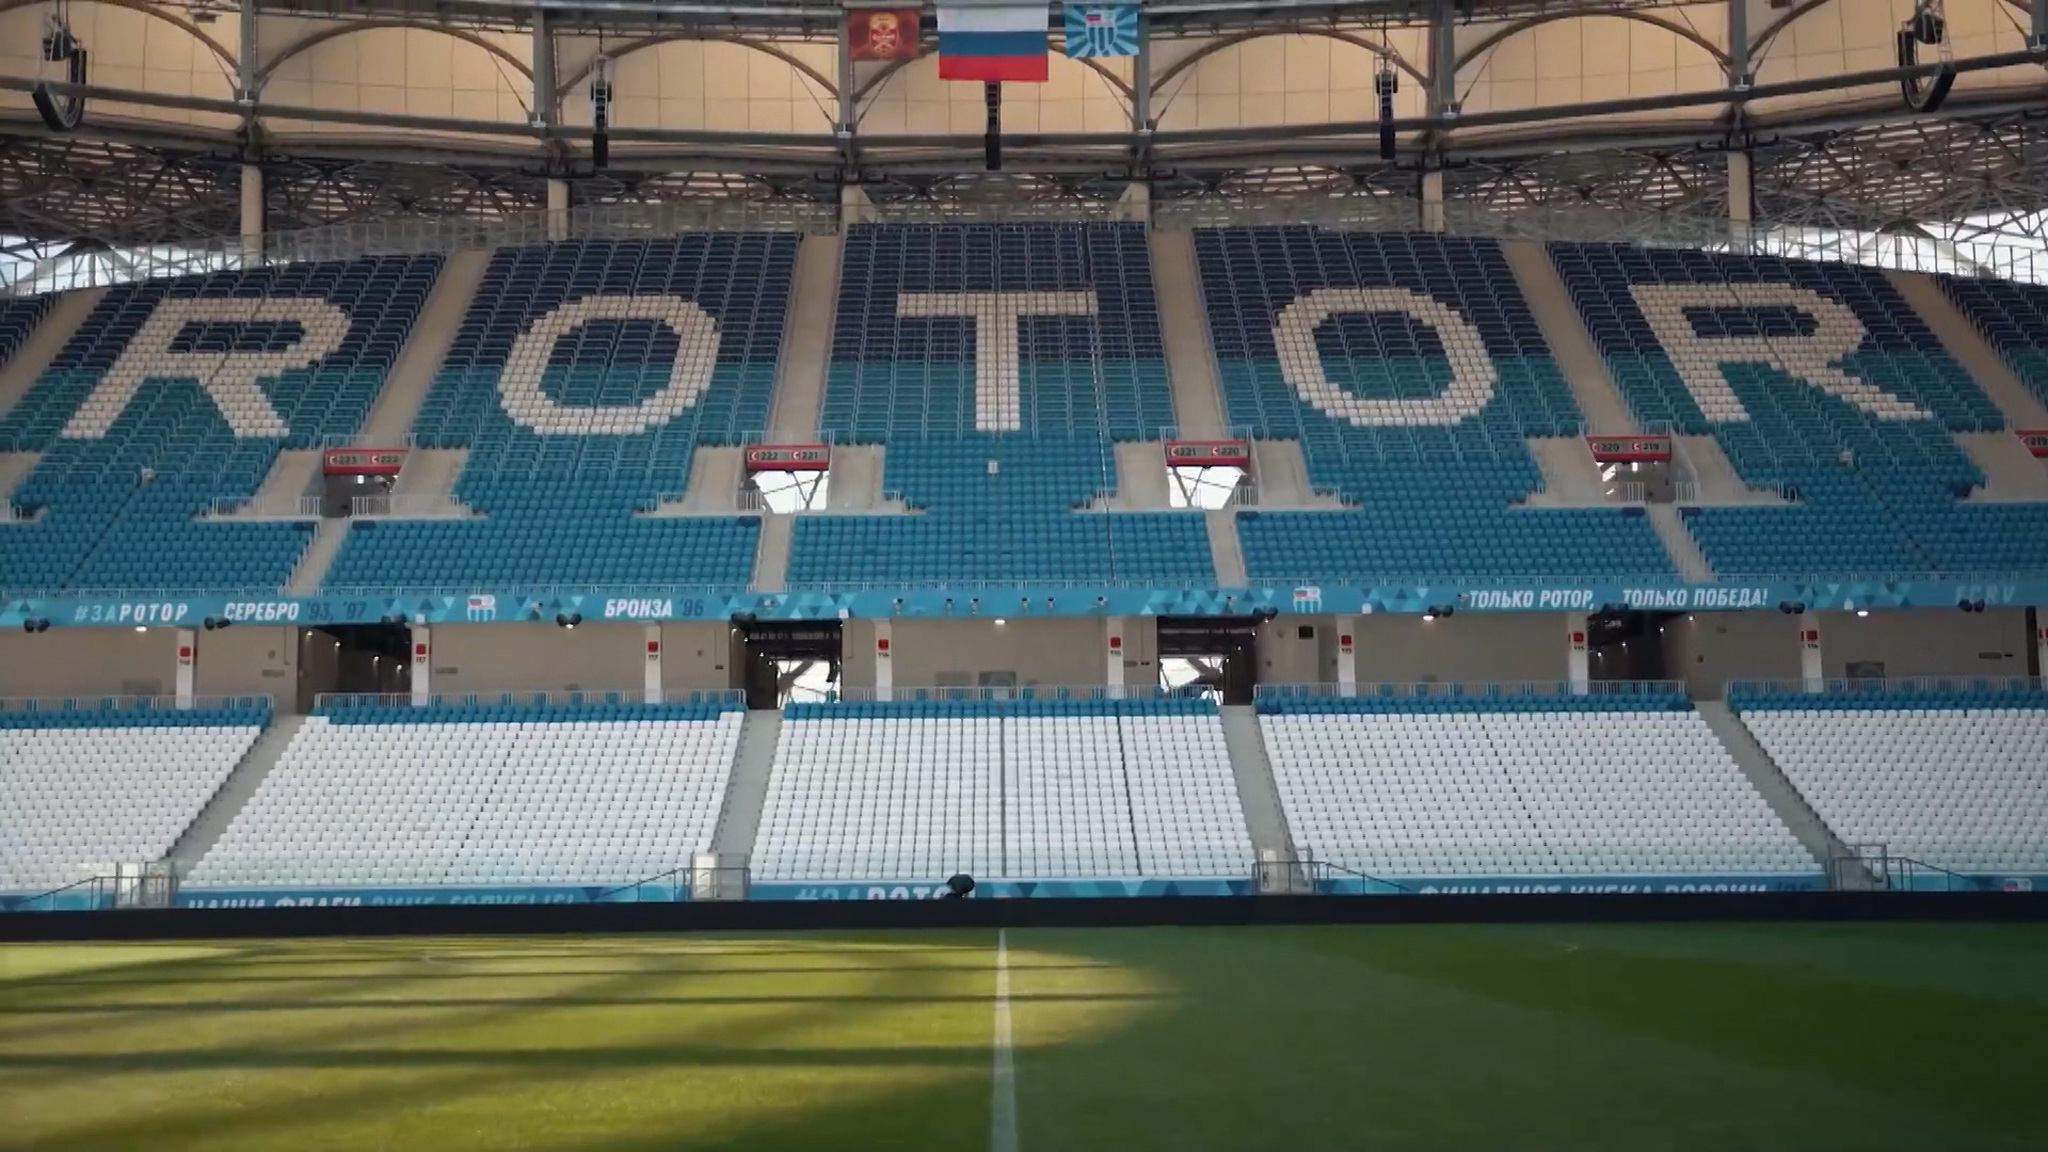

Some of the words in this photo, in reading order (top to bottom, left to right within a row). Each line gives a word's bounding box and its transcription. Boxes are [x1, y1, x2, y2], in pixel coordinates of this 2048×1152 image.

[62, 282, 1933, 439] ROTOR
[604, 598, 673, 618] БРОНЗА
[1468, 589, 1534, 609] ТОЛЬКО
[1539, 589, 1595, 610] РОТОР,
[1622, 588, 1688, 607] ТОЛЬКО
[1692, 587, 1769, 608] ПОБЕДА!
[223, 601, 300, 621] СЕРЕБРО
